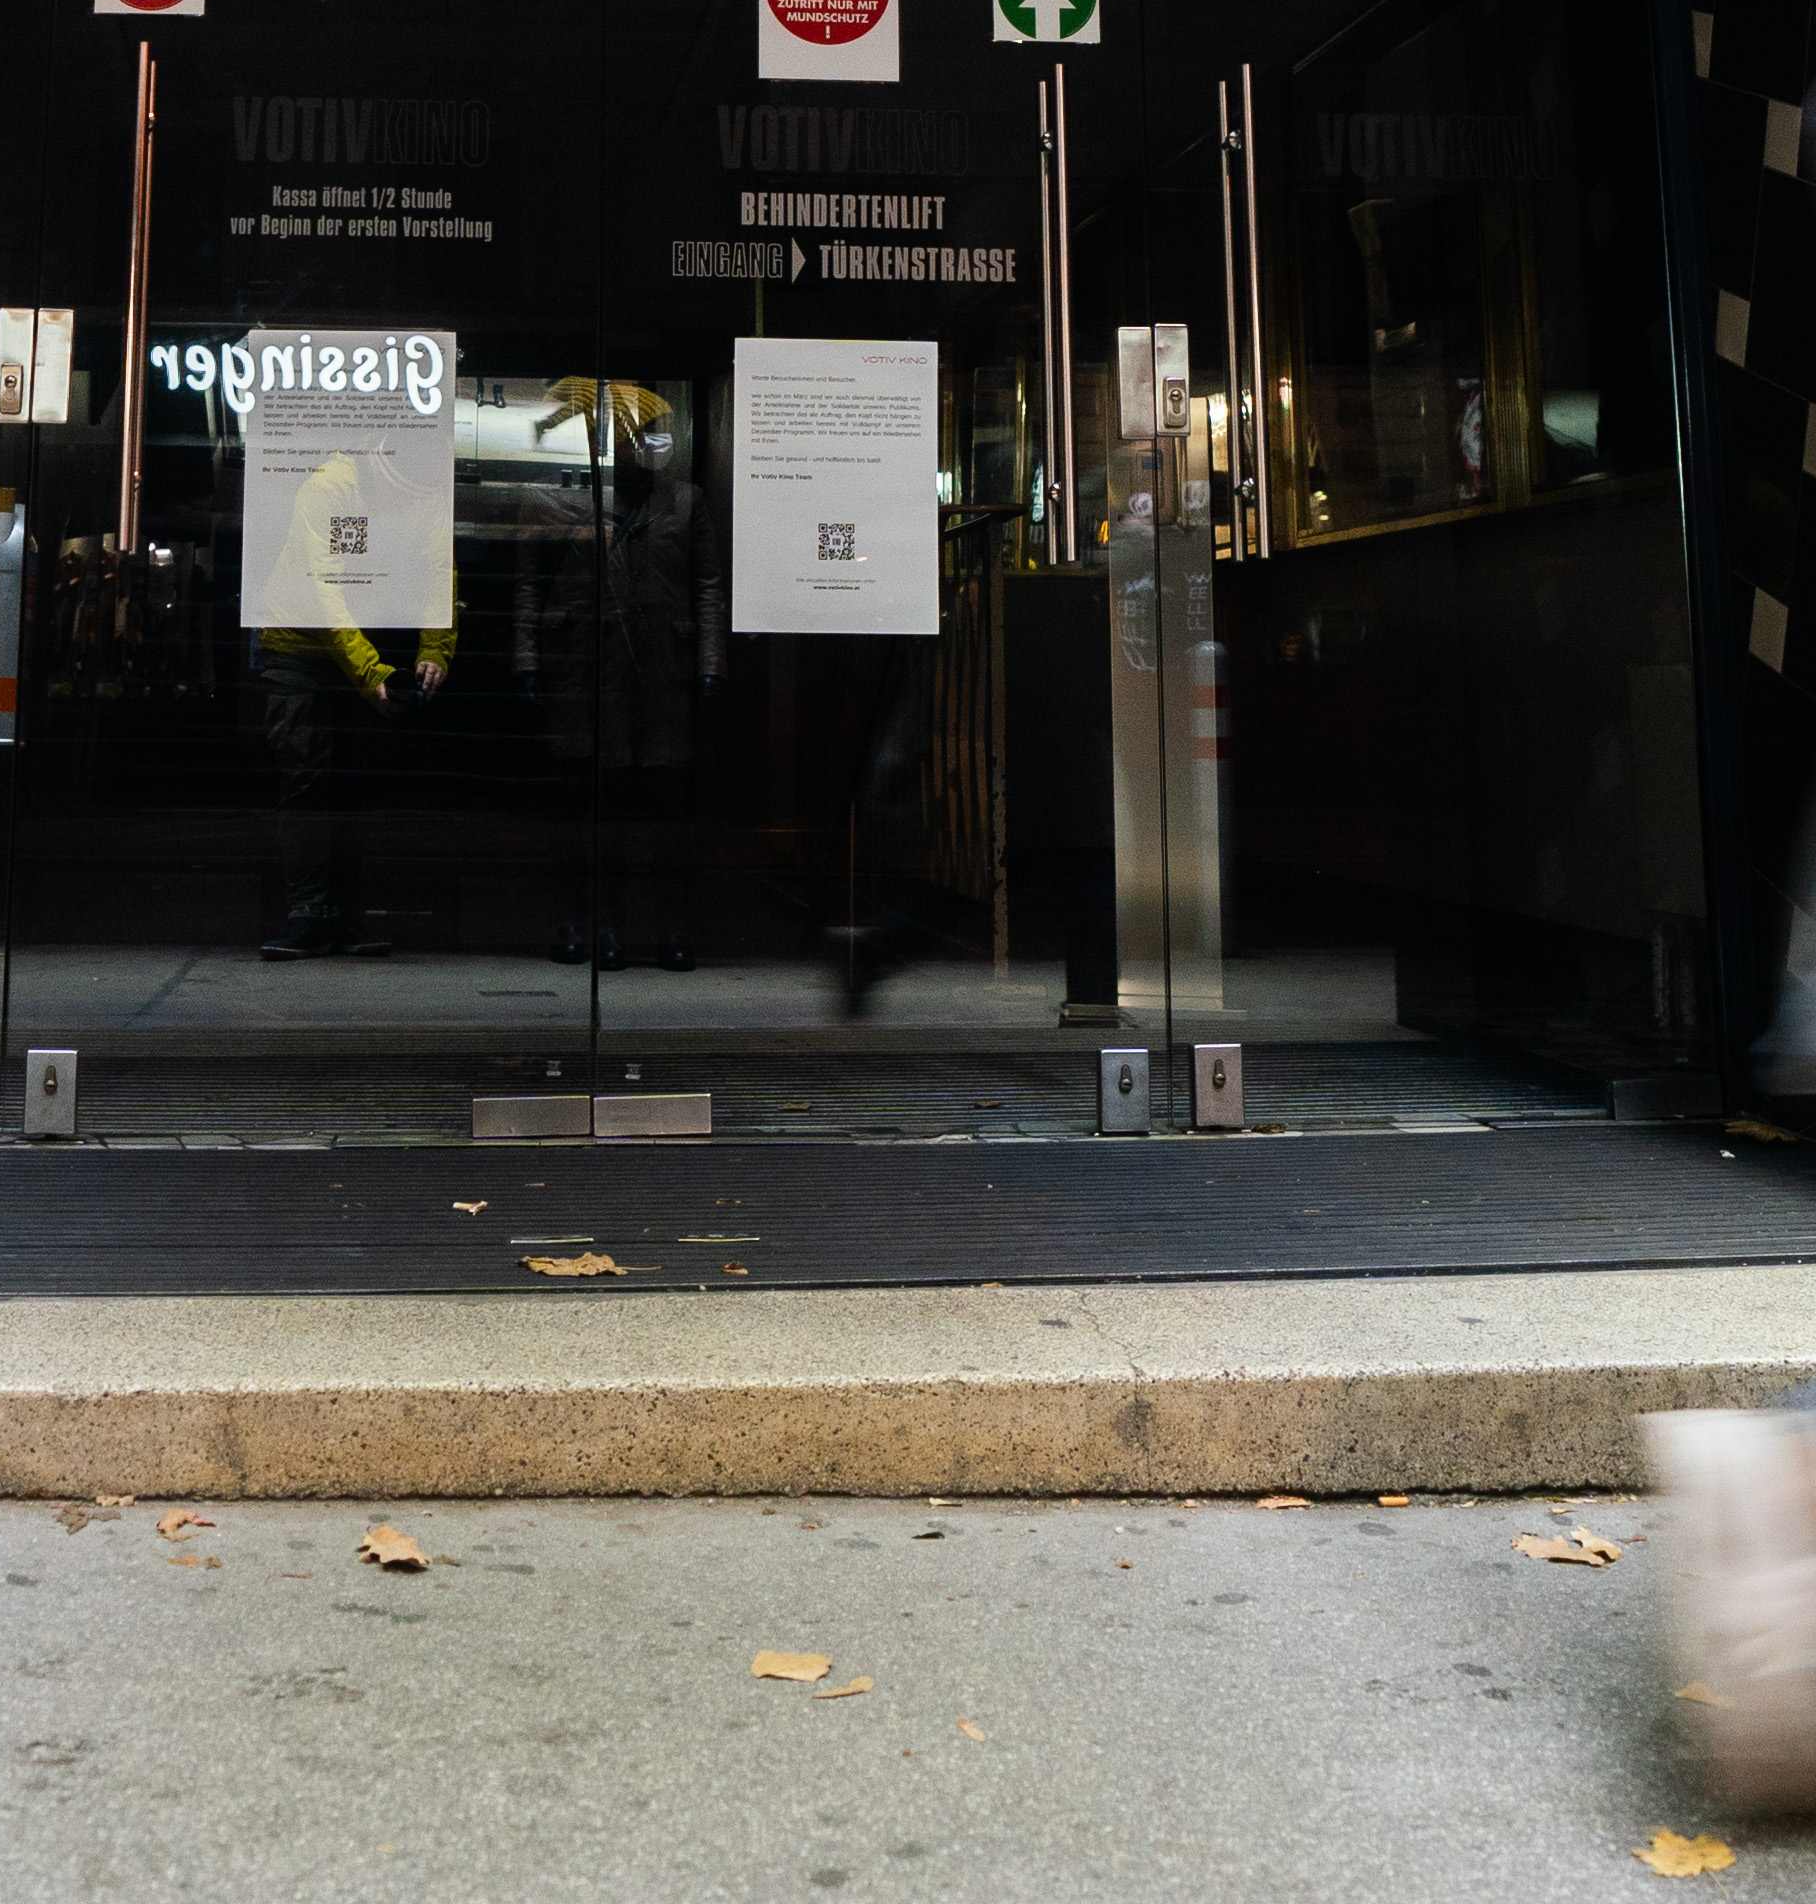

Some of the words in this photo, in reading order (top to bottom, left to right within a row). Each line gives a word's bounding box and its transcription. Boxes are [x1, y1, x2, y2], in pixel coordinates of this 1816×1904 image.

[786, 12, 869, 24] MUNDSCHUTZ
[827, 0, 853, 10] NUR
[857, 0, 879, 11] MIT
[272, 185, 316, 206] Kassa
[322, 186, 366, 207] öffnet
[371, 186, 395, 209] 1/2
[401, 187, 451, 208] Stunde
[740, 191, 945, 229] BEHINDERTENLIFT
[230, 217, 255, 234] vor
[260, 213, 311, 238] Beginn
[316, 215, 342, 235] der
[347, 215, 396, 237] ersten
[402, 216, 492, 242] Vorstellung
[671, 240, 783, 279] EINGANG
[819, 239, 1015, 282] TÜRKENSTRASSE
